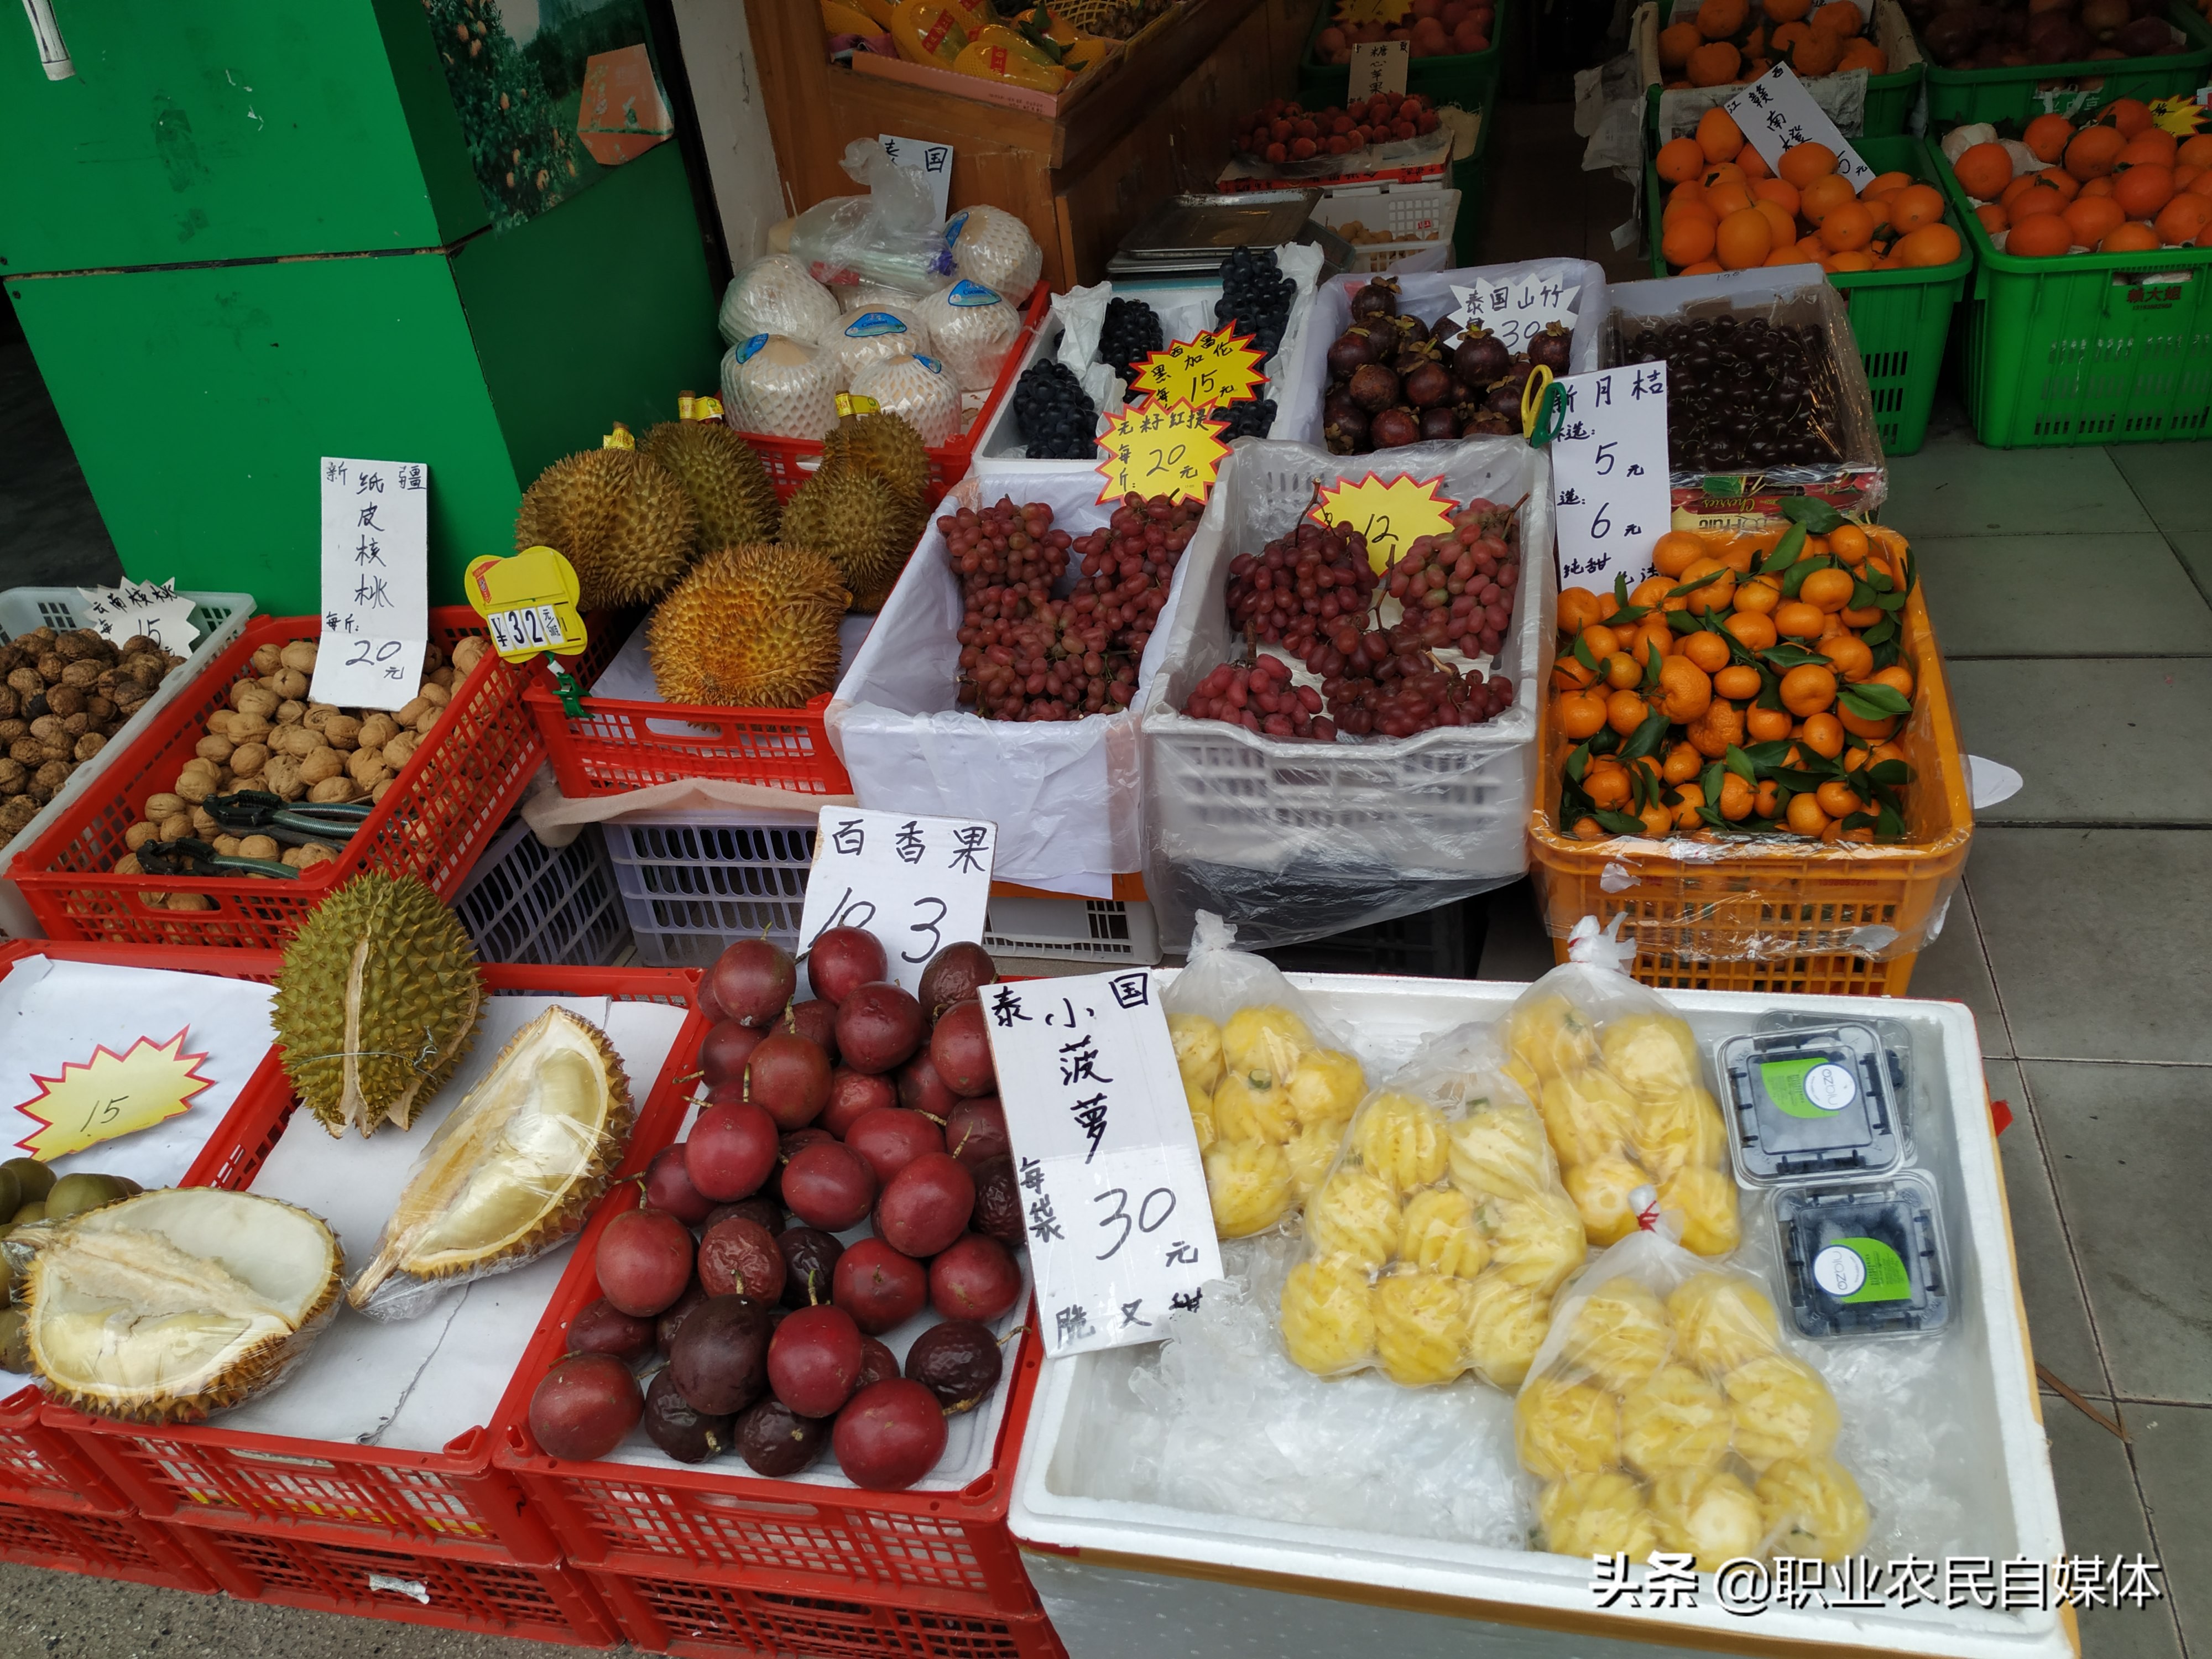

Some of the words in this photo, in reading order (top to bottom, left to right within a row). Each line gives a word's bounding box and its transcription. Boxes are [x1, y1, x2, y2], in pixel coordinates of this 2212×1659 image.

[925, 147, 948, 173] 国
[1855, 166, 1868, 177] 元
[1465, 283, 1564, 315] 泰国山竹
[1501, 320, 1541, 348] 30
[1191, 368, 1218, 403] 15
[1219, 384, 1235, 398] 元
[1118, 410, 1209, 437] 无籽红提
[1146, 444, 1186, 477] 20
[1179, 465, 1199, 479] 元
[1594, 442, 1618, 476] 5
[1626, 463, 1645, 478] 元
[1590, 502, 1610, 539] 6
[1702, 498, 1756, 512] Cherries
[354, 472, 395, 609] 纸皮核桃
[1362, 513, 1400, 545] 12
[1623, 523, 1642, 538] 元
[1563, 552, 1612, 579] 纯甜
[93, 583, 178, 614] 云南核桃
[138, 618, 161, 649] 15
[345, 640, 402, 666] 20
[384, 666, 405, 680] 元
[832, 818, 989, 874] 百香果
[901, 897, 948, 964] 3
[992, 985, 1034, 1027] 泰
[1108, 972, 1149, 1009] 国
[80, 1095, 129, 1133] 15
[1019, 1157, 1065, 1244] 每袋
[1093, 1186, 1177, 1261] 30
[1165, 1241, 1199, 1267] 元
